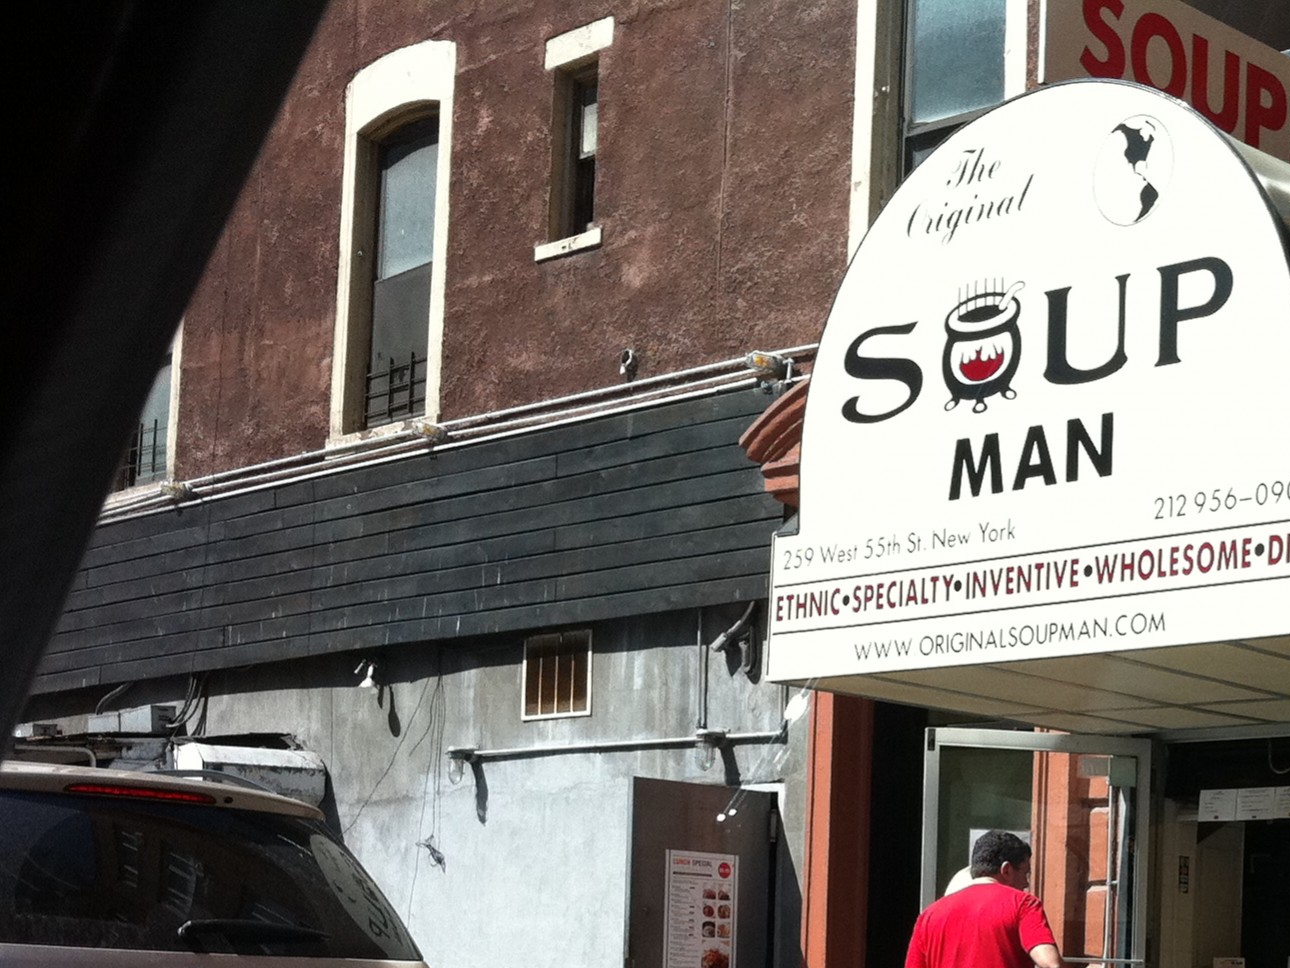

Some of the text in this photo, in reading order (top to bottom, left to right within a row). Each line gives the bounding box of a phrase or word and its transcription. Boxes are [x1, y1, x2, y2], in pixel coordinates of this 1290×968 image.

[946, 147, 1002, 190] The
[906, 173, 1035, 245] Original
[841, 256, 1234, 424] SOUP
[948, 411, 1114, 502] MAN
[1153, 494, 1188, 520] 212
[782, 547, 815, 570] 259
[819, 543, 858, 564] West
[863, 533, 902, 560] 55th
[932, 528, 972, 550] New
[979, 517, 1016, 543] York
